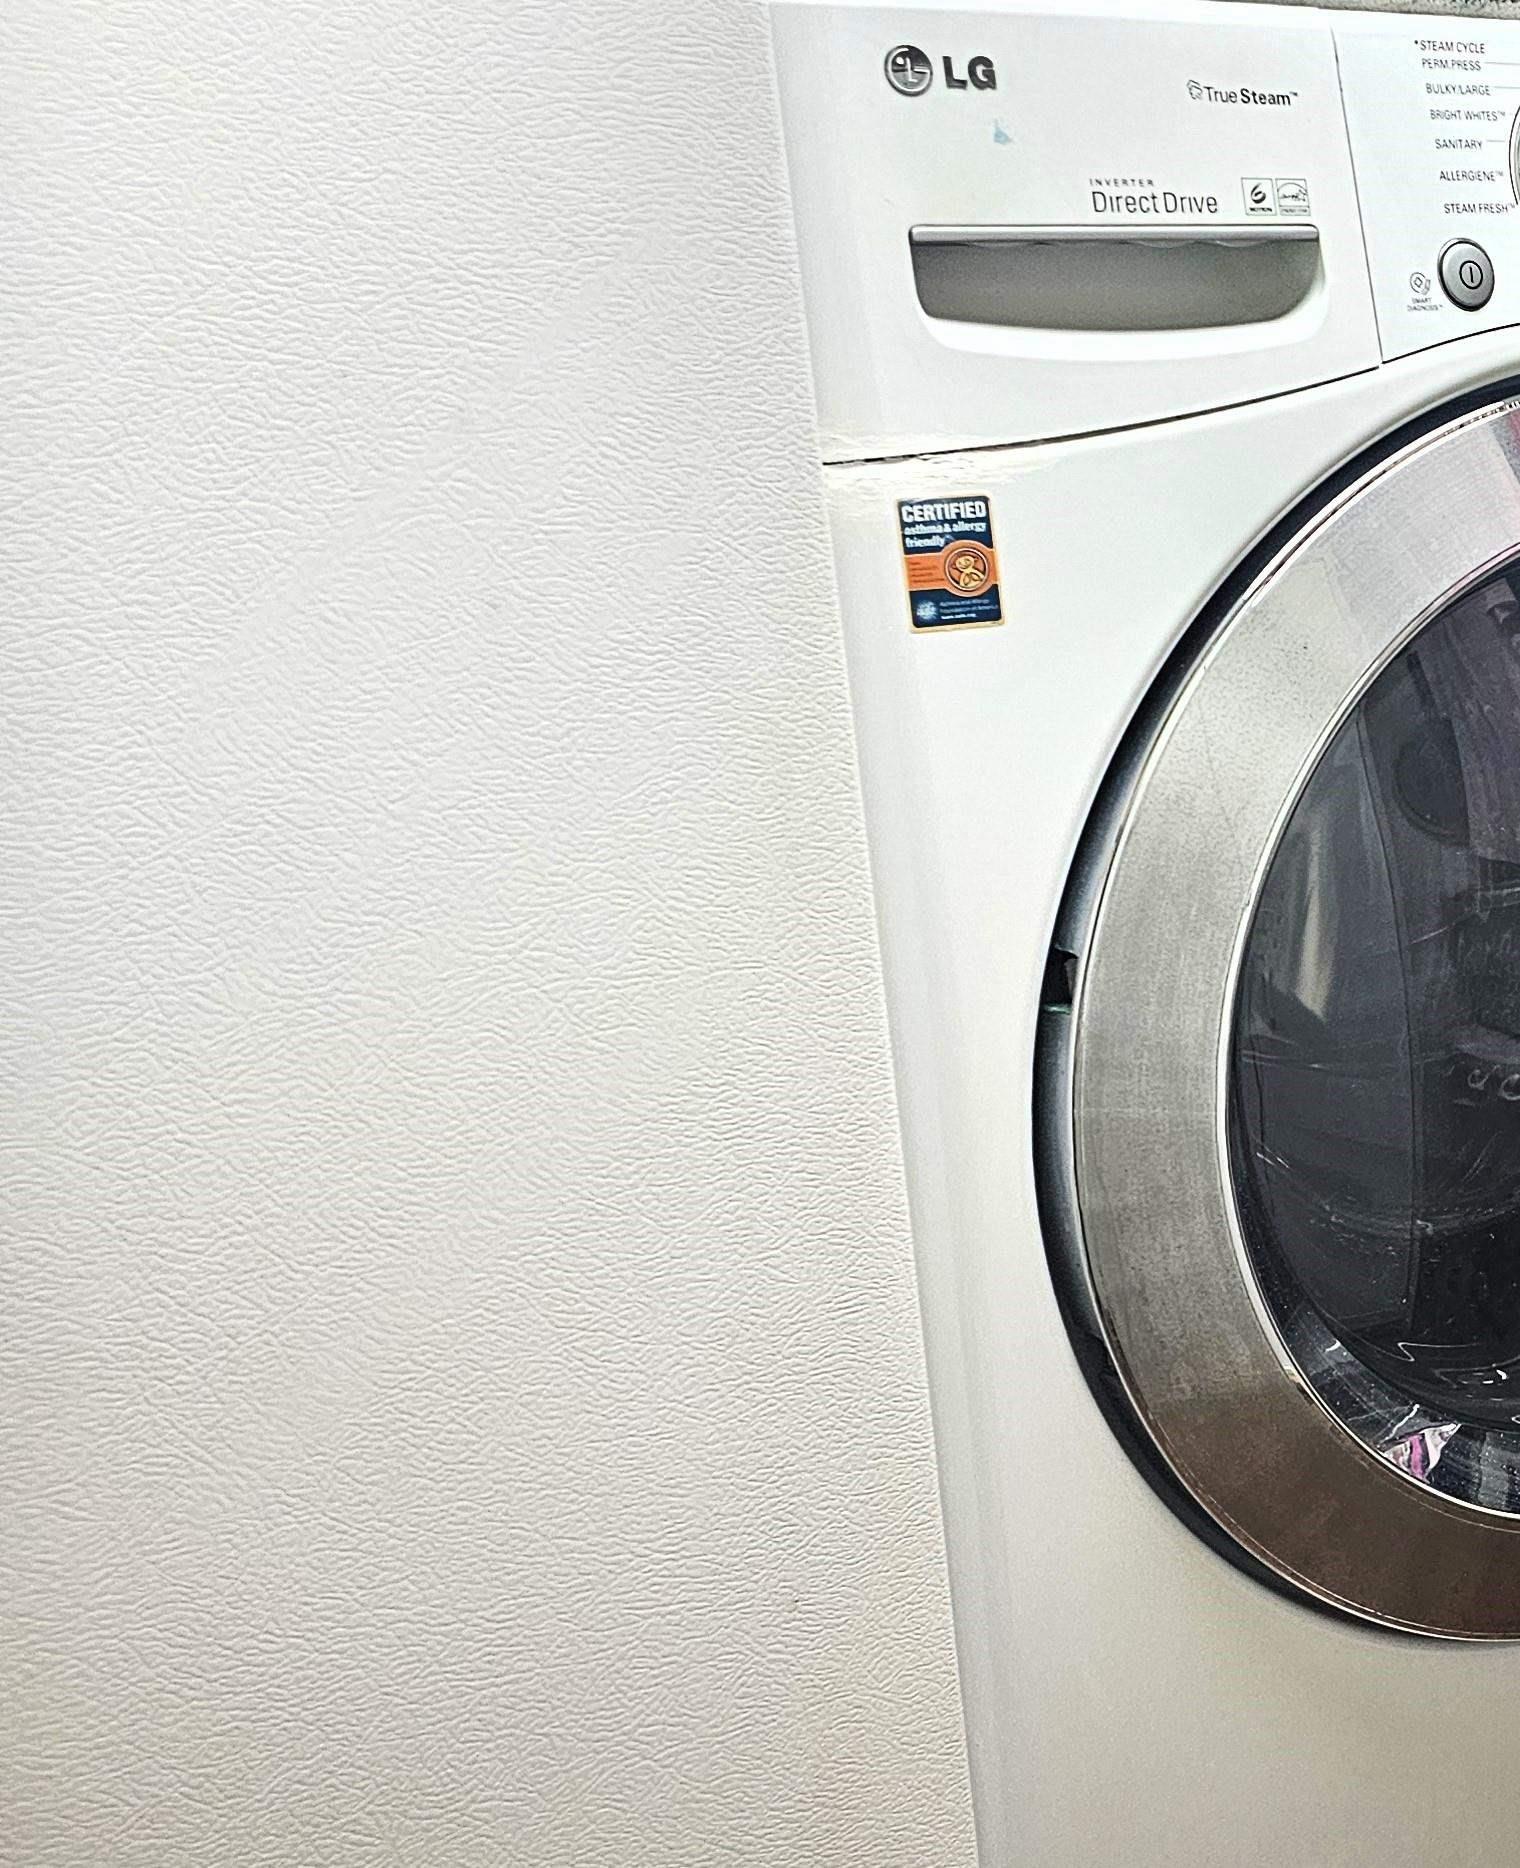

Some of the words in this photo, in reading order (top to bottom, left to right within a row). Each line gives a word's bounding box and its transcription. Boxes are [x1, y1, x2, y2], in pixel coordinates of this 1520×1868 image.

[942, 55, 998, 90] LG
[1430, 108, 1461, 120] BRIGHT
[1434, 138, 1483, 151] SANITARY
[1089, 178, 1155, 188] INVERTER
[1091, 190, 1161, 214] Direct
[1163, 192, 1219, 214] Drive
[1443, 202, 1477, 214] STEAM
[901, 501, 987, 523] CERTIFIED
